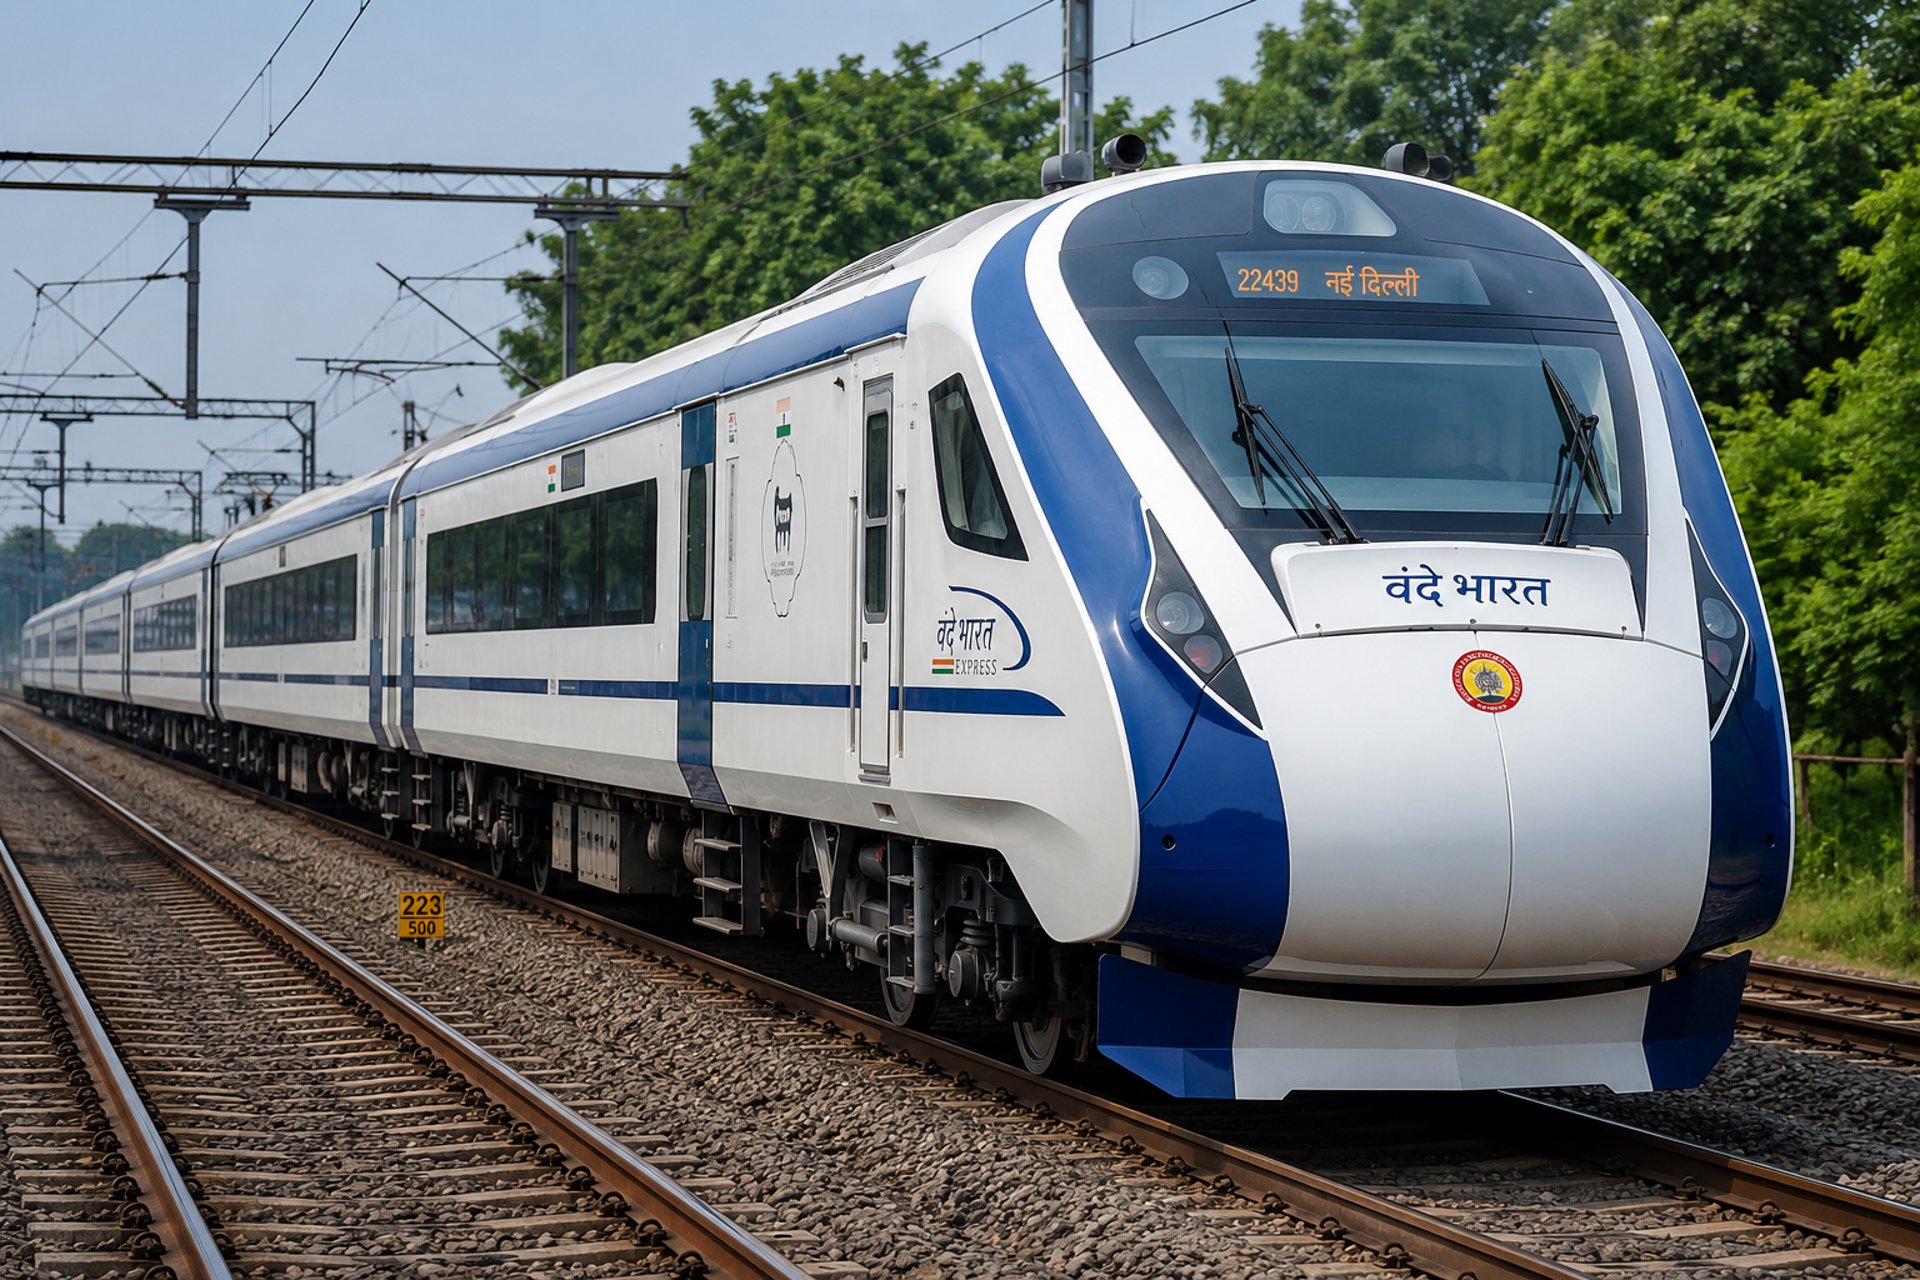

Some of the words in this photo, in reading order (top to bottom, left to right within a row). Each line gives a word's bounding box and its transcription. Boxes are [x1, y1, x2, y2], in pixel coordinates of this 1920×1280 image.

[1238, 268, 1299, 292] 22439
[1325, 265, 1354, 297] नई
[1359, 265, 1420, 297] दिल्ली
[1382, 564, 1443, 607] वंदे
[1453, 574, 1551, 606] भारत
[959, 618, 996, 651] भारत
[955, 659, 997, 675] EXPRESS
[403, 895, 441, 915] 223
[409, 921, 436, 935] 500
